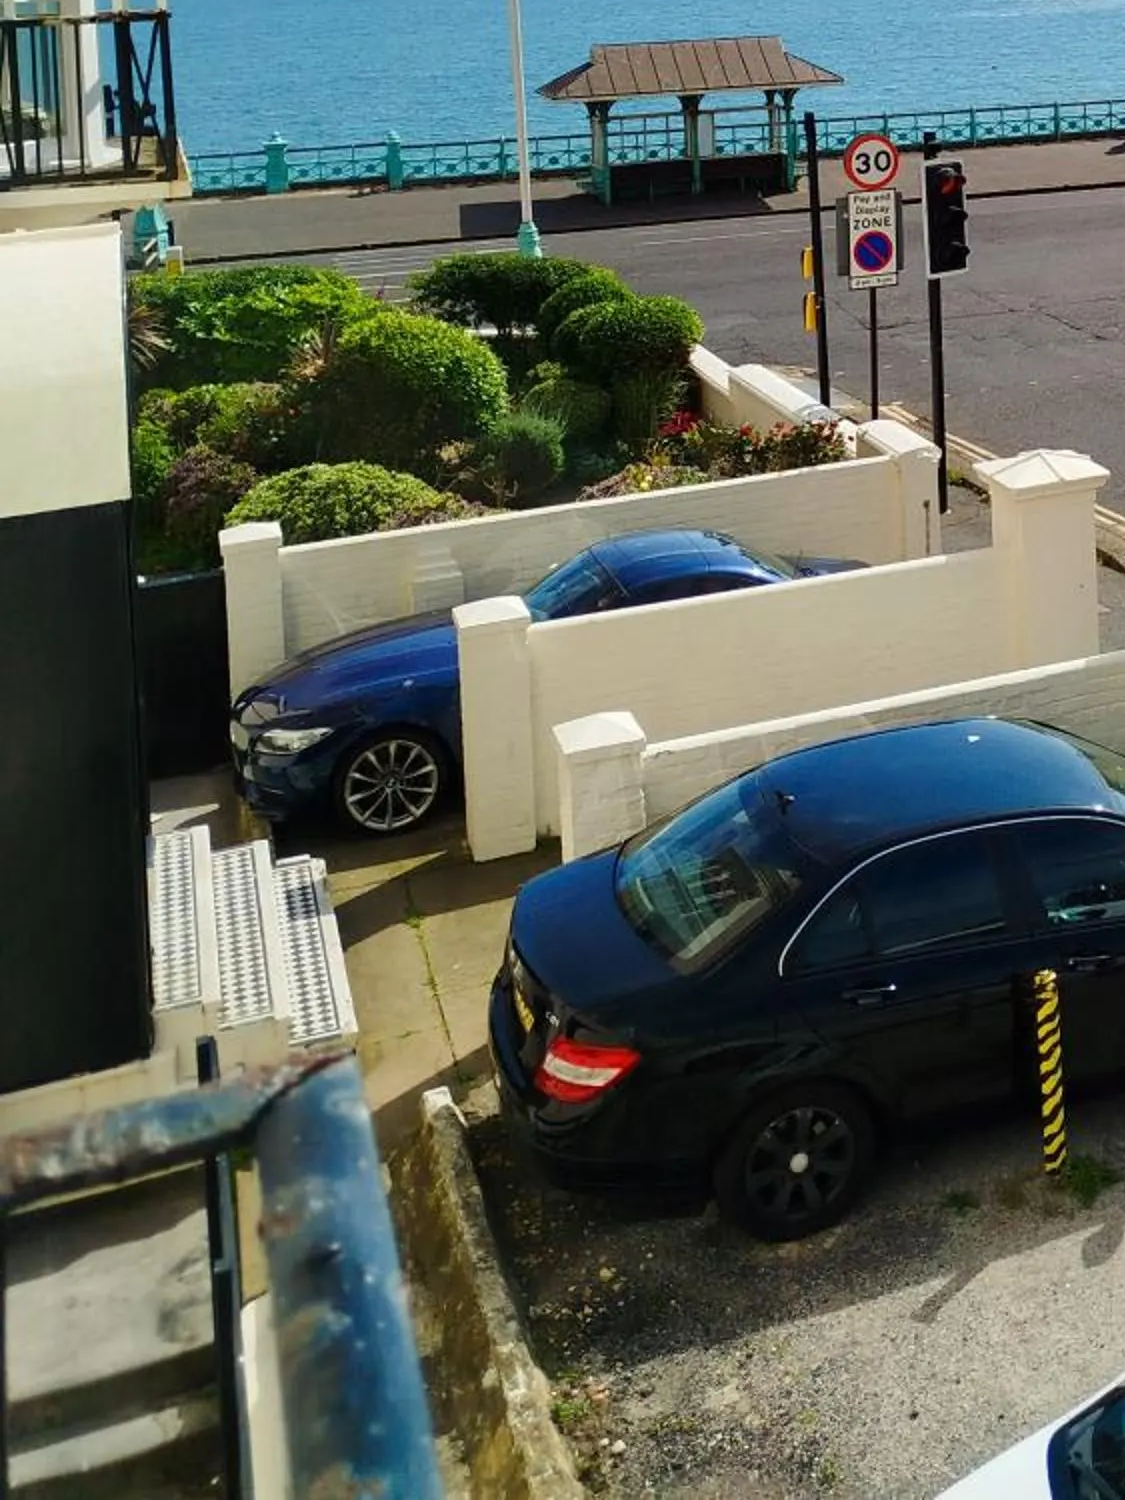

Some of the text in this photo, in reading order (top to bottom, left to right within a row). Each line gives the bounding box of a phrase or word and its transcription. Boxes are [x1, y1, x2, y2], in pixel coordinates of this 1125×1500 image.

[855, 150, 891, 174] 30
[854, 193, 891, 204] Pay and
[855, 204, 890, 215] Display
[853, 216, 892, 230] ZONE
